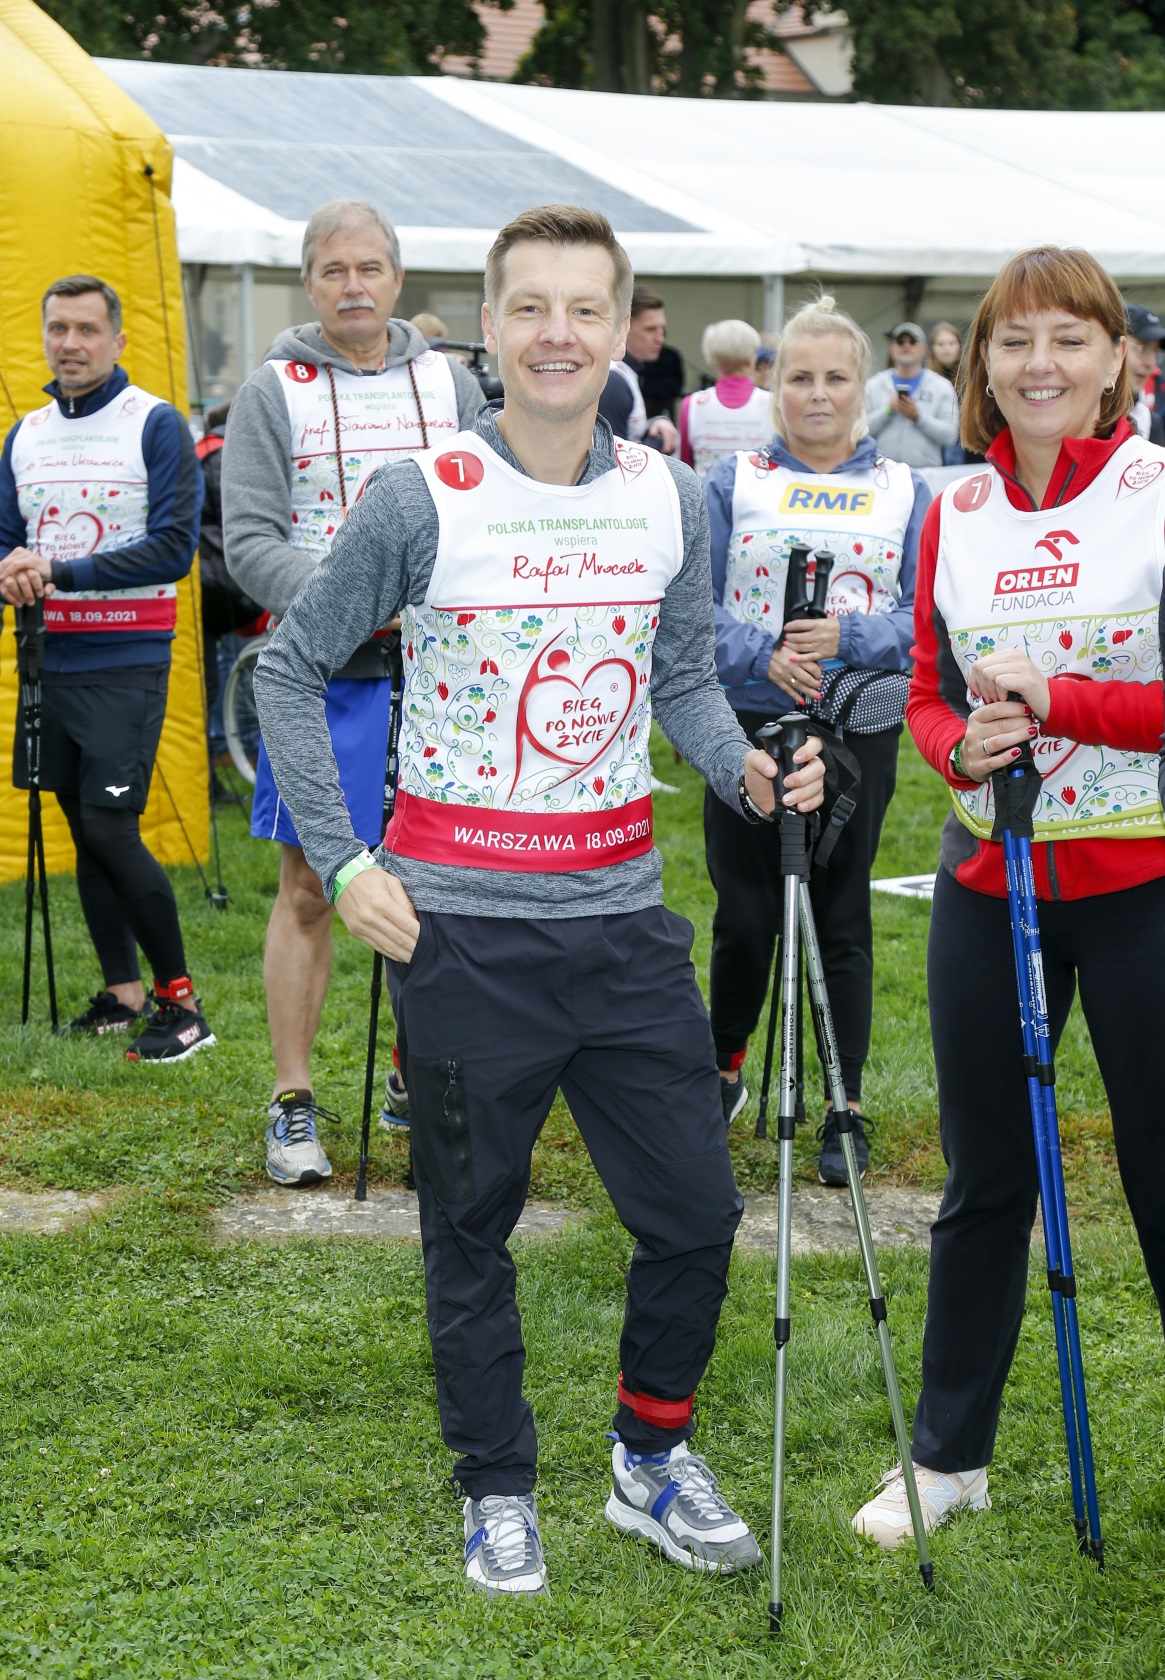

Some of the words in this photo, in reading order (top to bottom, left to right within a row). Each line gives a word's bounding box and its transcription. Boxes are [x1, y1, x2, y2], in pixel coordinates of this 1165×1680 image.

[294, 364, 308, 379] 8
[352, 391, 437, 401] TRANSPLANTOOGIĘ
[450, 458, 466, 483] 7
[788, 488, 869, 512] RMF
[971, 481, 983, 504] 7
[487, 520, 536, 535] POLSKĄ
[537, 517, 650, 533] TRANSPLANTOLOGIĘ
[54, 533, 76, 541] BIEG
[58, 541, 88, 551] NOWE
[554, 534, 598, 548] wspiera
[577, 551, 649, 579] Mroczek
[999, 566, 1075, 592] ORLEN
[826, 596, 848, 606] IEG
[990, 590, 1075, 613] FUNDACJA
[69, 610, 138, 623] 18.09.2021
[562, 697, 603, 715] BIEG
[545, 720, 567, 734] PO
[570, 709, 619, 729] NOWE
[556, 727, 607, 749] ŻYCIE
[1031, 738, 1064, 757] YCIE
[453, 826, 577, 851] WARSZAWA
[584, 817, 651, 850] 18.09.2021
